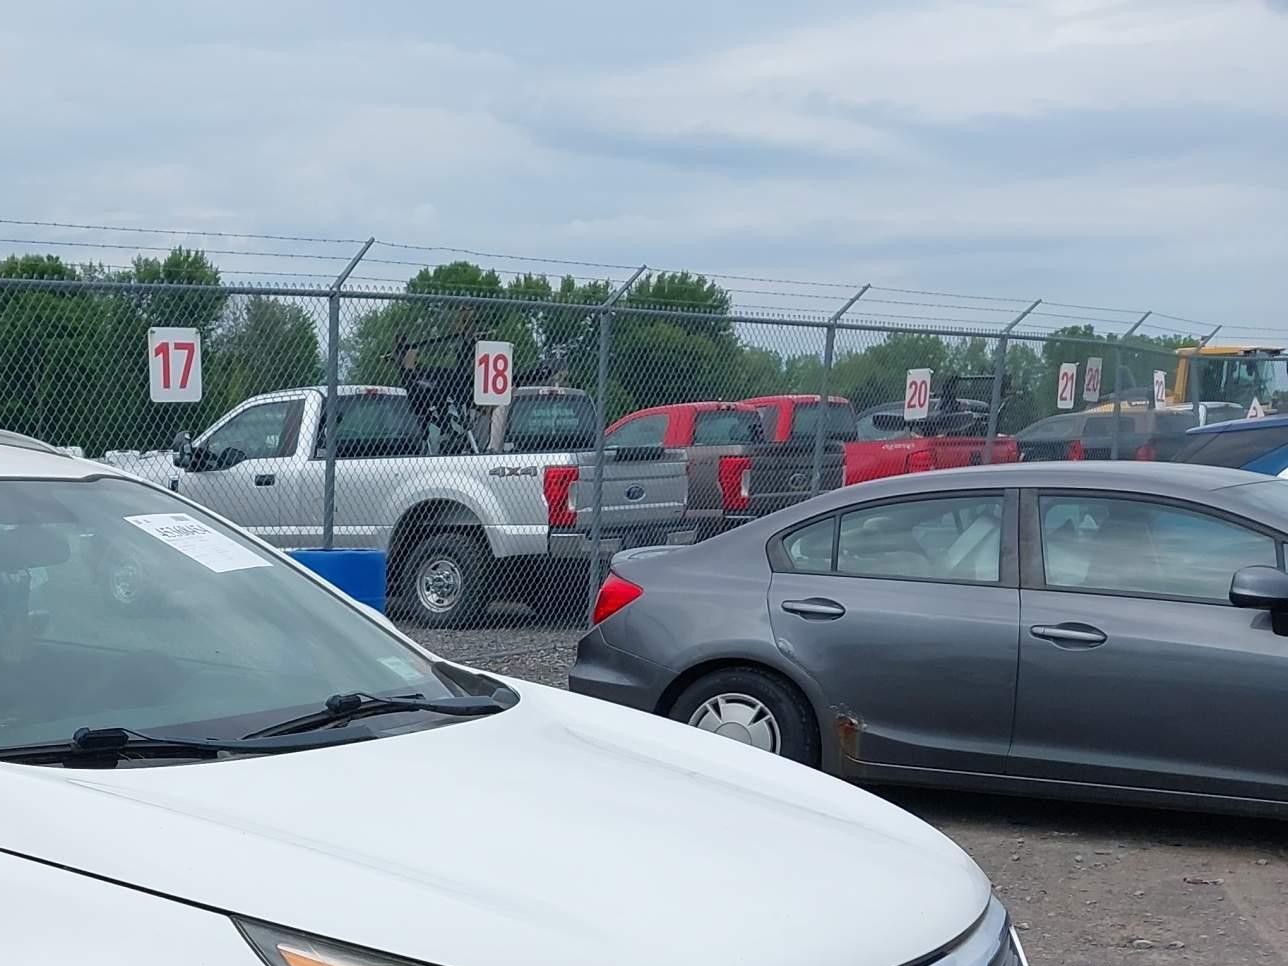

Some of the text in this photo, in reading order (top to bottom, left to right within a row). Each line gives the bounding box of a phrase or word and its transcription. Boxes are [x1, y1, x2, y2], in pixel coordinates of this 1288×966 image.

[154, 342, 195, 389] 17
[478, 353, 509, 395] 18
[907, 380, 928, 409] 20
[1060, 371, 1075, 401] 21
